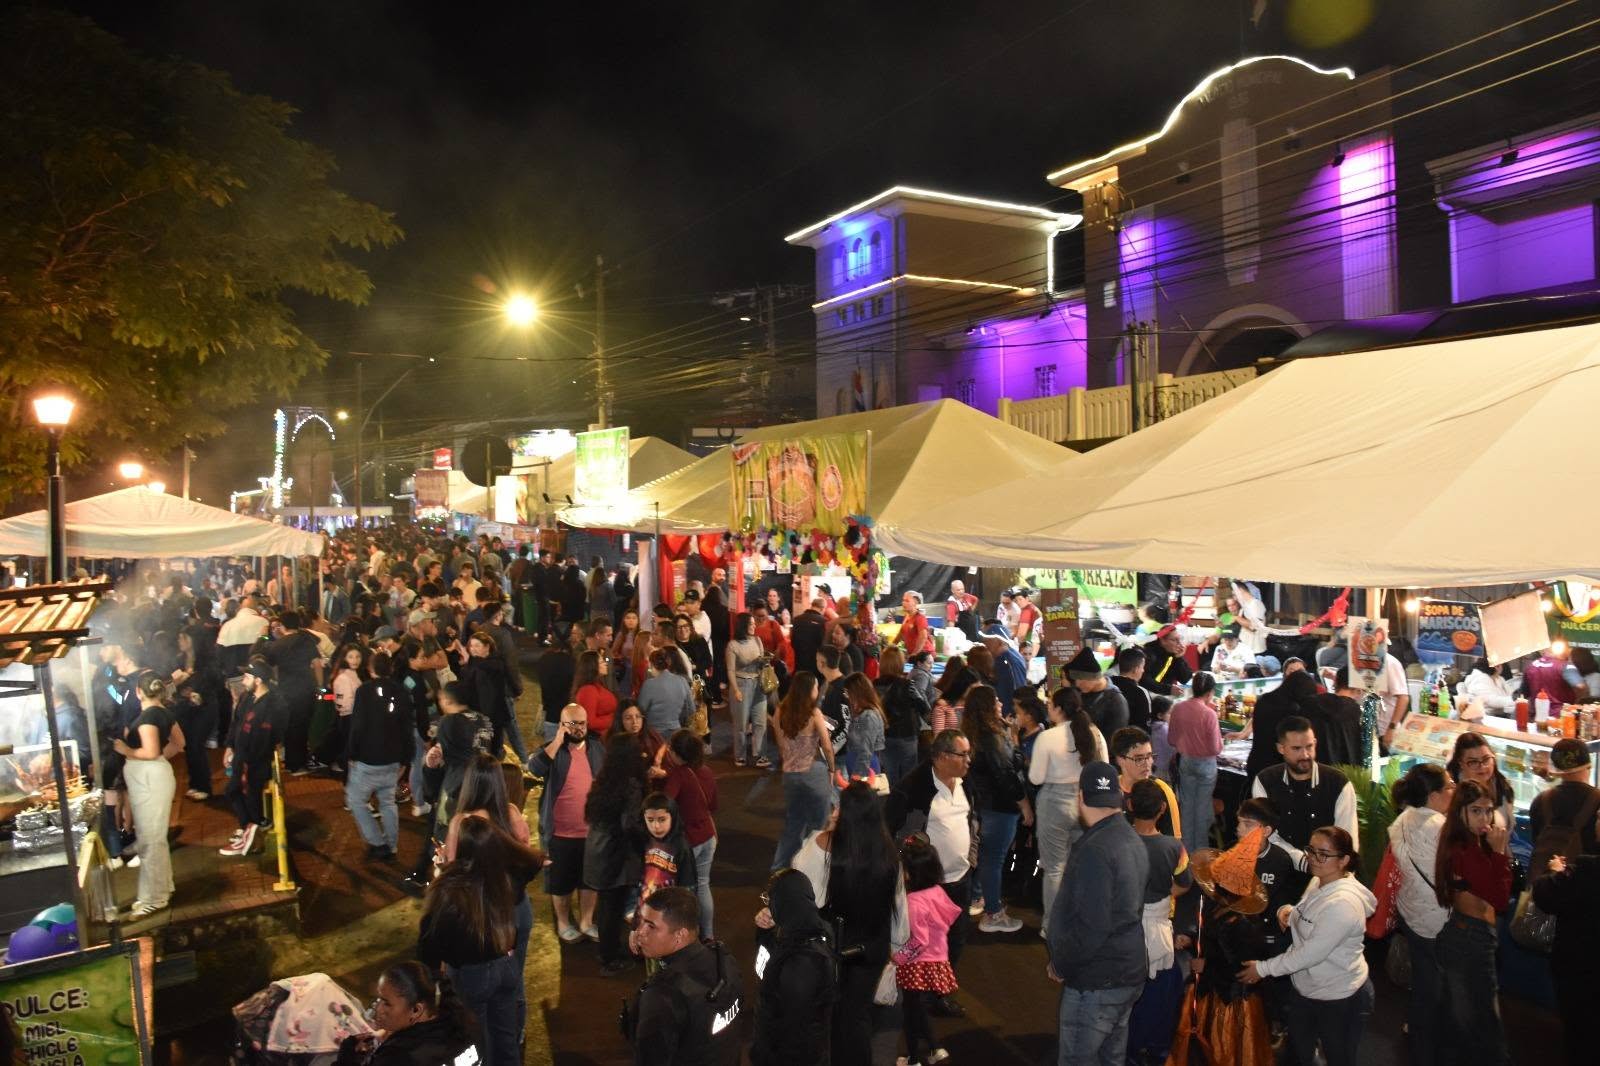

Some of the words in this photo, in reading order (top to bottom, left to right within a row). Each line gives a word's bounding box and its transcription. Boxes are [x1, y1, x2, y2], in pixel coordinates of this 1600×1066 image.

[1074, 569, 1135, 590] RRALES
[1045, 611, 1077, 622] TAMAL
[1424, 604, 1449, 616] SOPA
[1452, 605, 1465, 617] DE
[1418, 616, 1480, 631] MARISCOS
[1262, 873, 1275, 885] 02
[25, 1021, 66, 1042] MIEL
